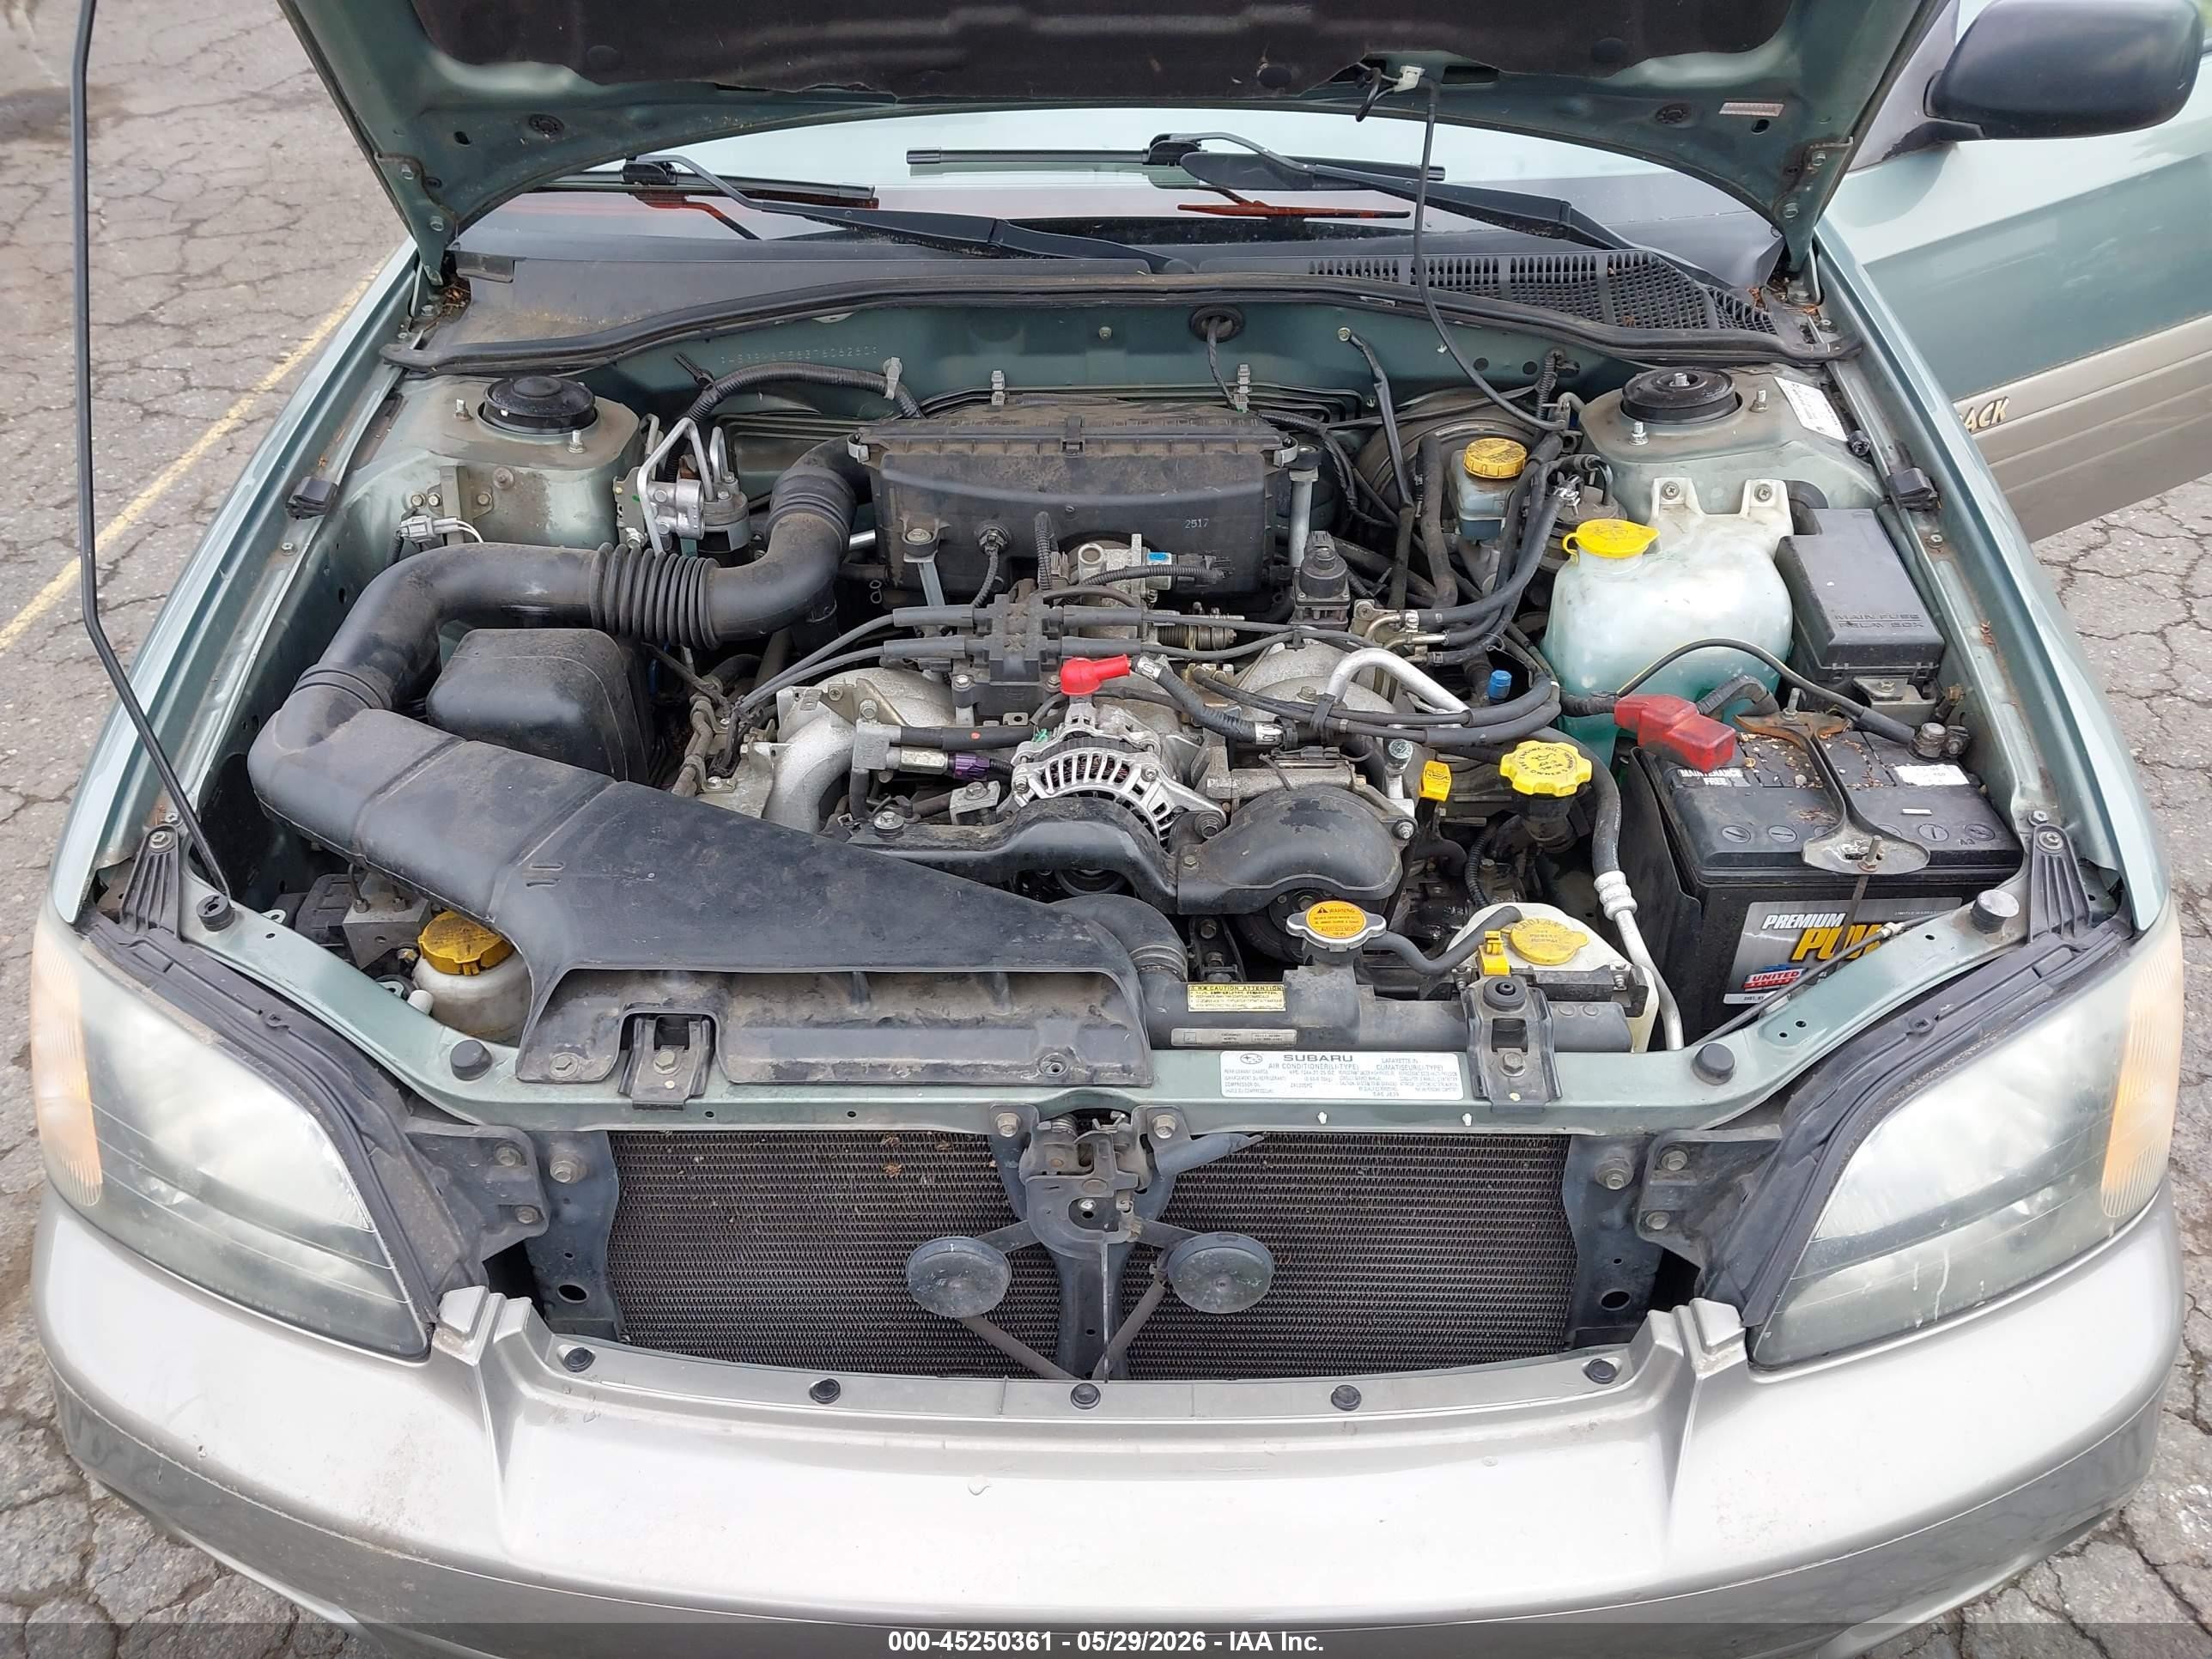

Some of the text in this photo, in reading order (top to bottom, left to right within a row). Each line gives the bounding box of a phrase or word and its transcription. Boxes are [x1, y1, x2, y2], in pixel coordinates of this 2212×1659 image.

[1959, 397, 2010, 434] ACK
[1185, 519, 1209, 529] 2517
[1761, 913, 1846, 930] PREMIUM
[1753, 970, 1800, 981] UNITED
